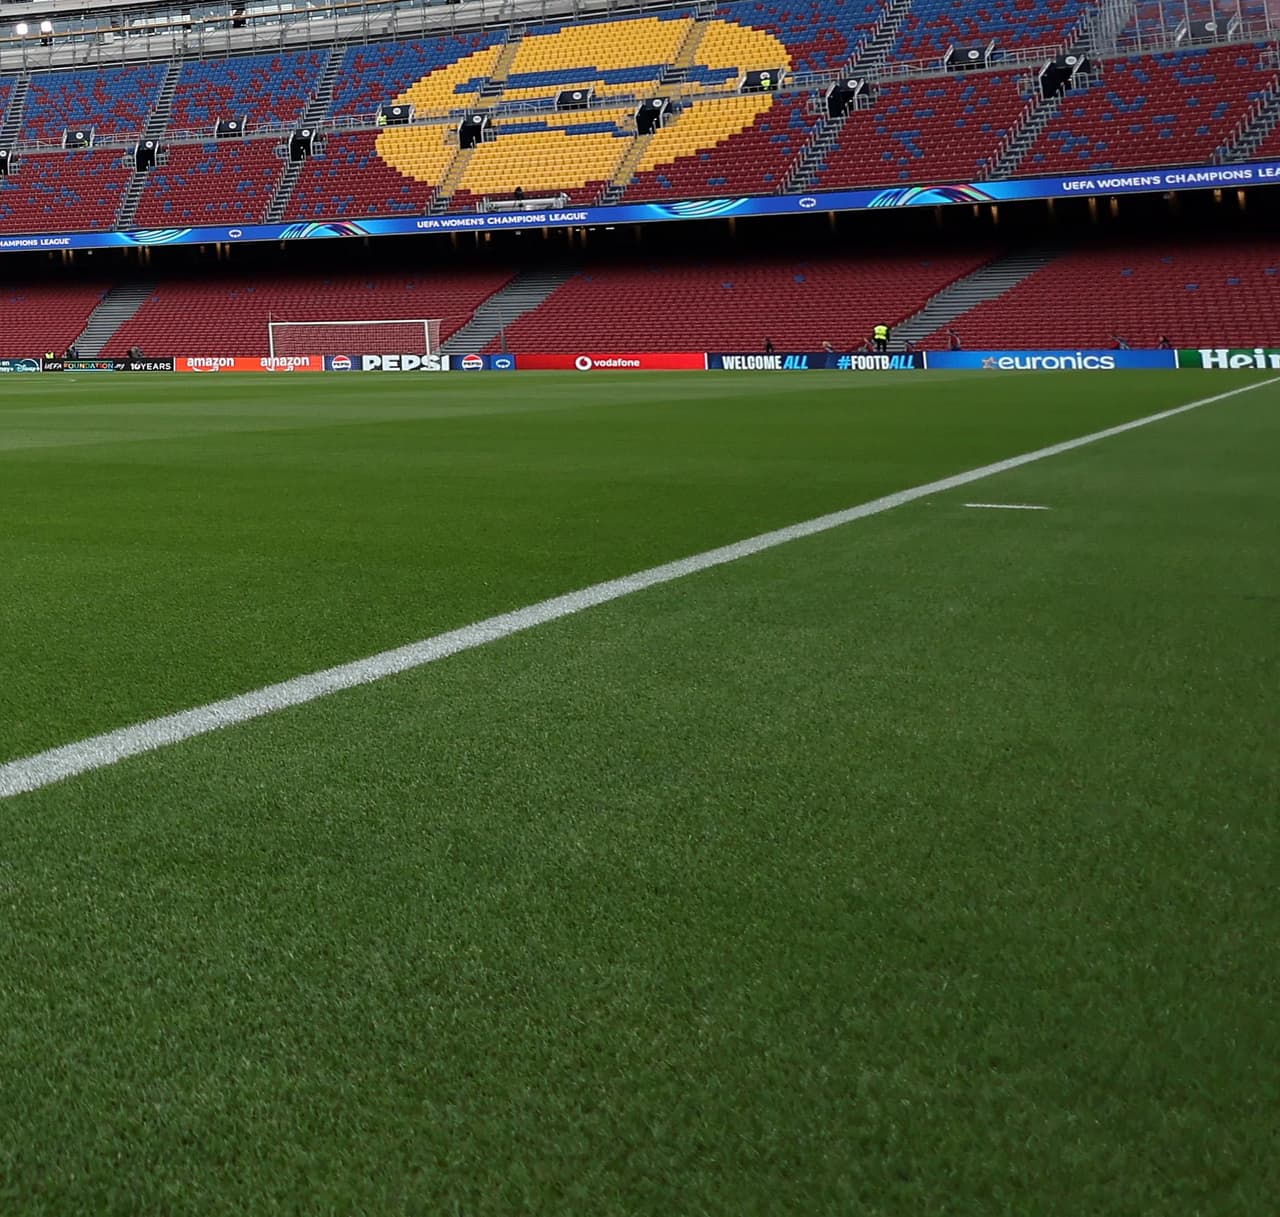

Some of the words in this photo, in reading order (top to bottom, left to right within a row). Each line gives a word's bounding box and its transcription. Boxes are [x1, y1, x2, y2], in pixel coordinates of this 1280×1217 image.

[1062, 181, 1095, 191] UEFA
[1097, 175, 1160, 189] WOMEN'S
[1165, 169, 1252, 184] CHAMPIONS
[416, 220, 440, 229] UEFA
[441, 217, 484, 227] WOMEN'S
[487, 214, 546, 225] CHAMPIONS
[186, 357, 235, 367] amazon
[260, 356, 310, 367] amazon
[362, 355, 450, 371] PEPSI
[593, 358, 641, 367] vodafone
[721, 355, 783, 369] WELCOME
[783, 355, 809, 369] ALL
[836, 355, 915, 370] #FOOTBALL
[997, 351, 1115, 370] euronics
